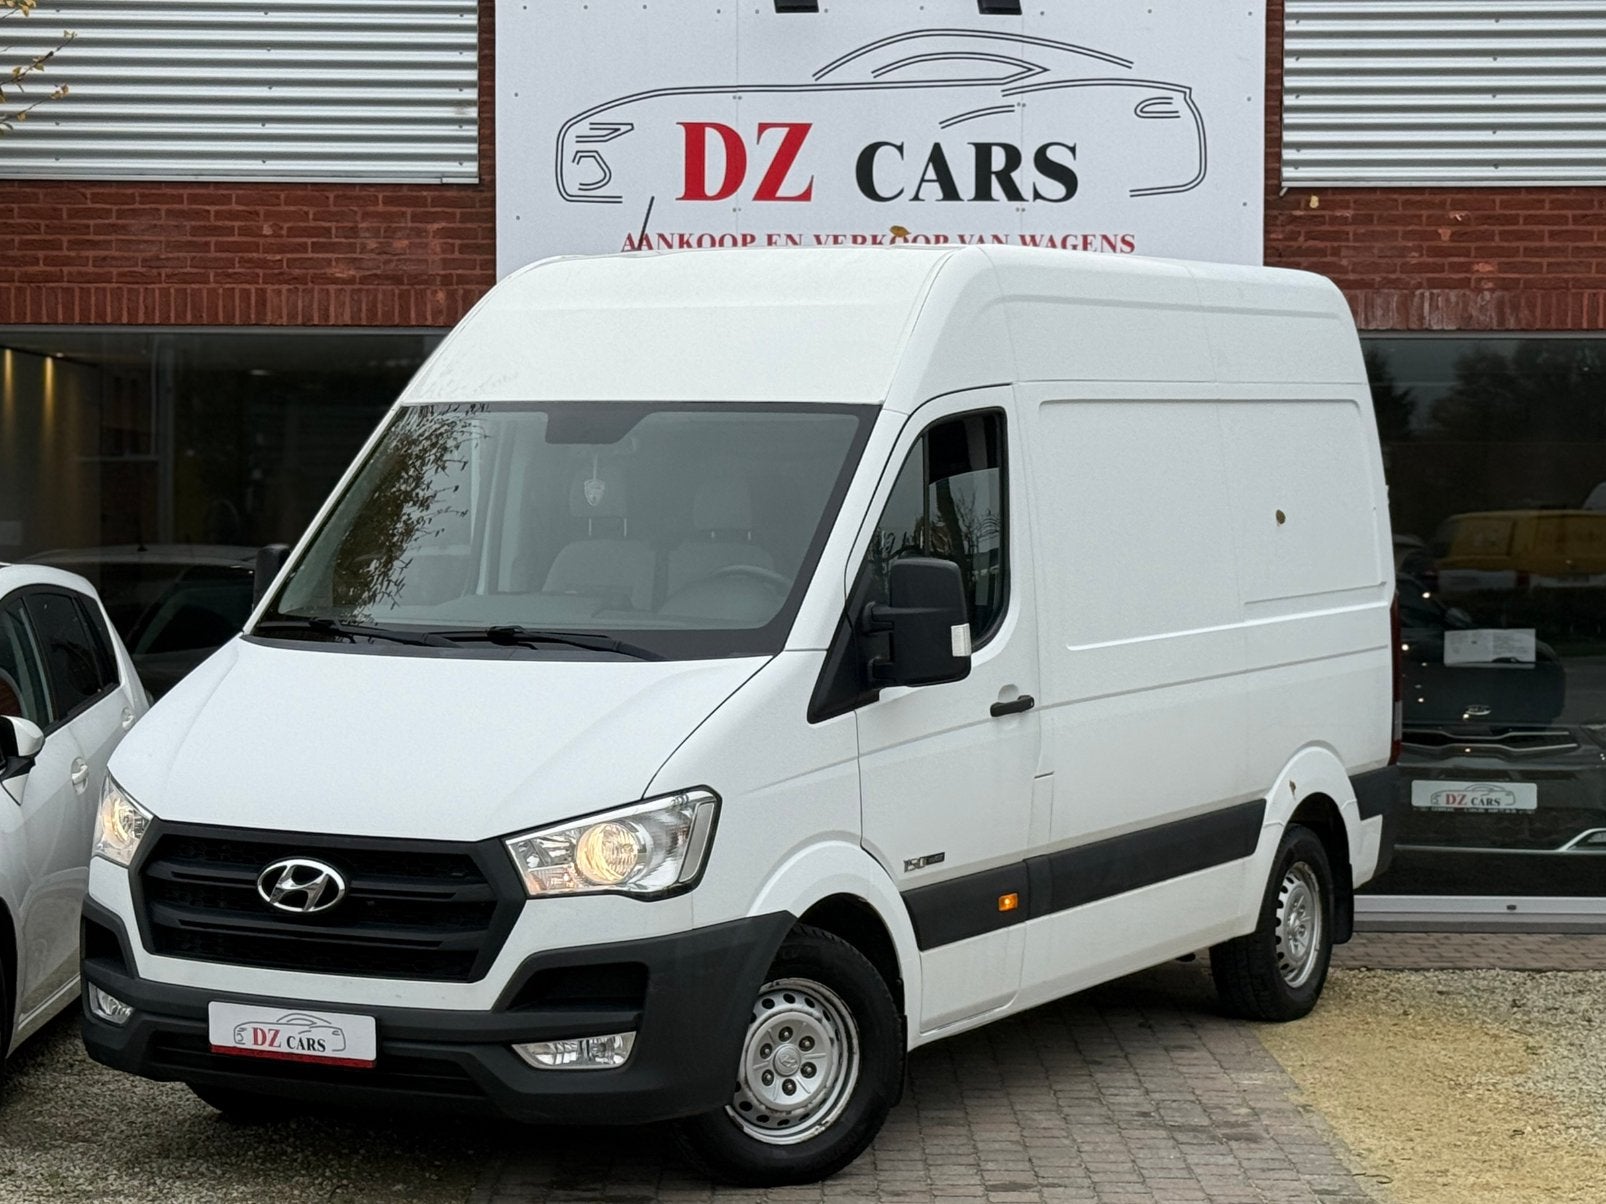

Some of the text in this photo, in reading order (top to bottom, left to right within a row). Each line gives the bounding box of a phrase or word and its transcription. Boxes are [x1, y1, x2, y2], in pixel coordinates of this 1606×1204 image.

[675, 122, 1079, 203] DZ CARS
[620, 232, 757, 252] AANKOOP
[766, 233, 804, 247] EN
[1018, 233, 1136, 254] WAGENS
[1445, 793, 1501, 807] DZ CARS
[252, 1026, 326, 1053] DZ CARS
